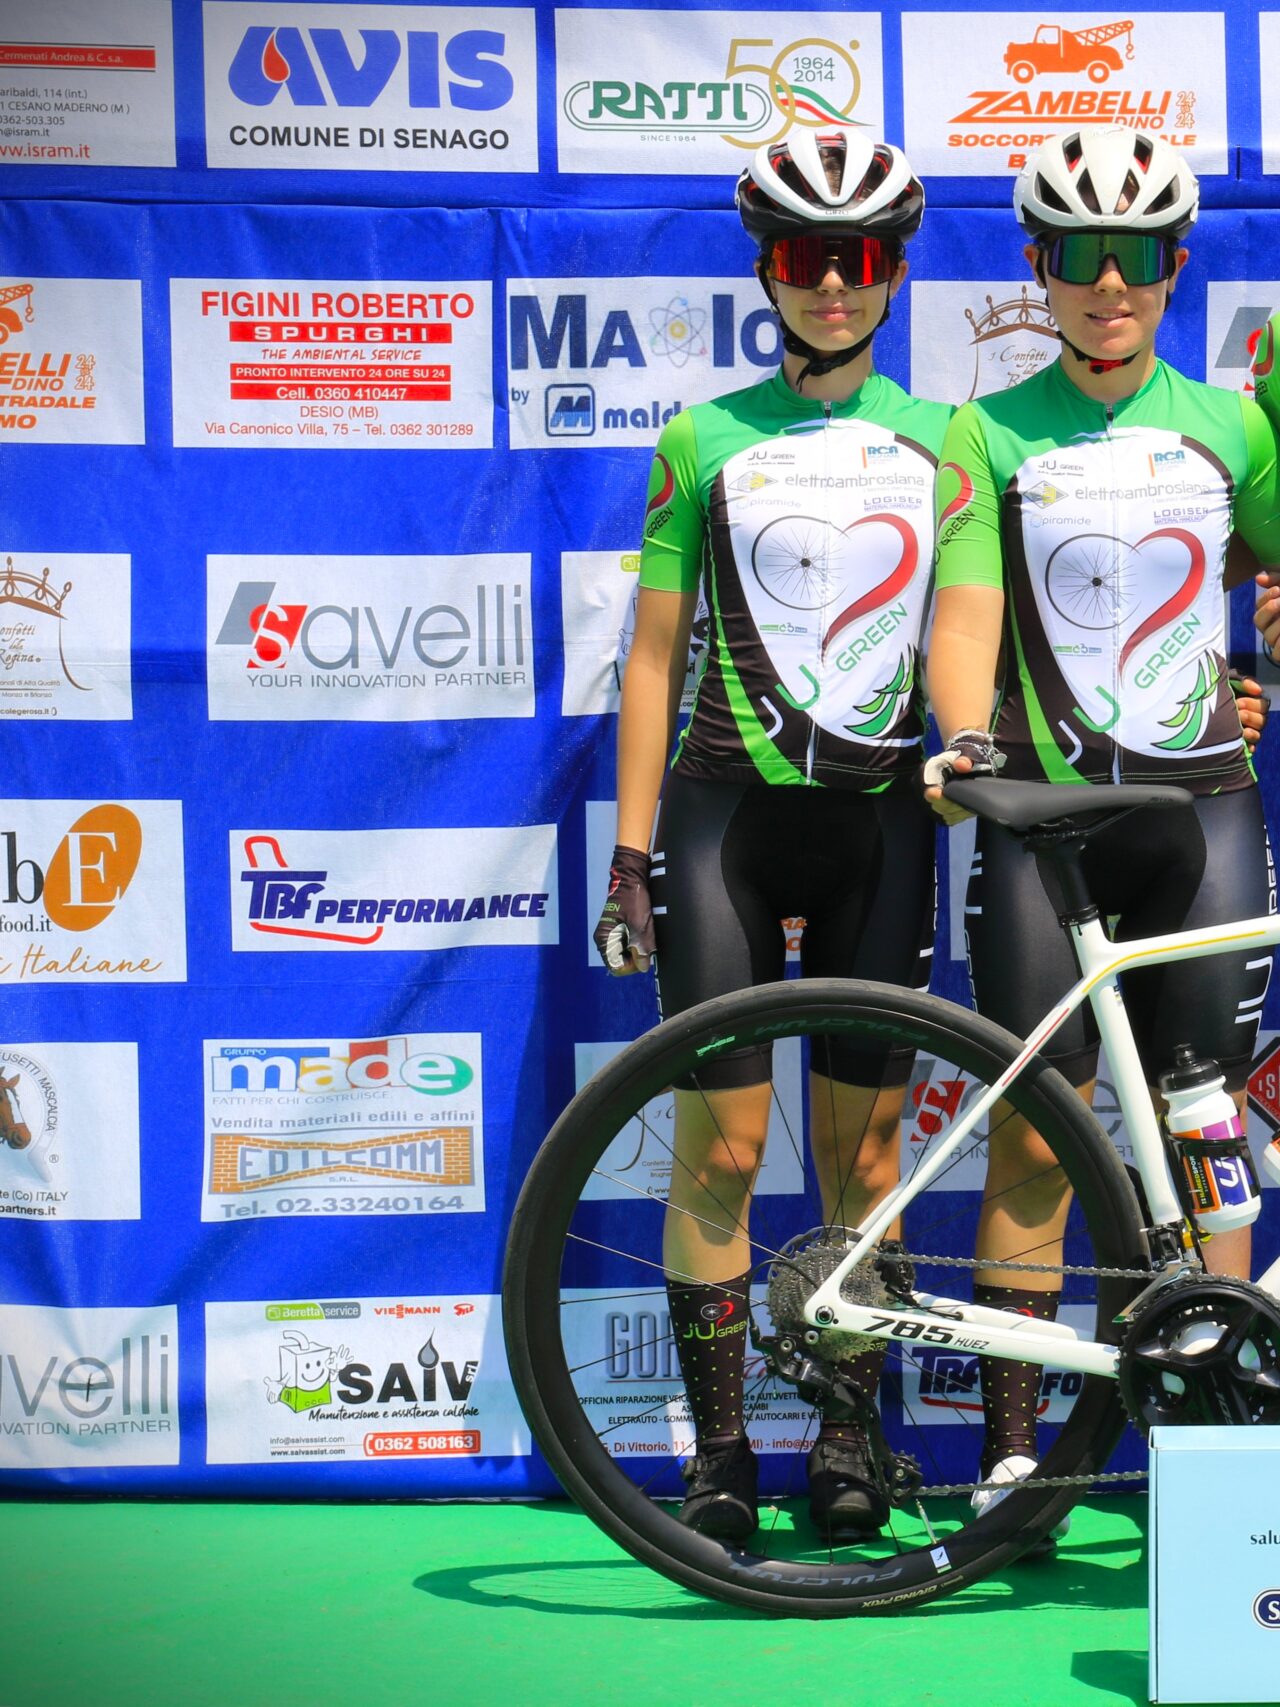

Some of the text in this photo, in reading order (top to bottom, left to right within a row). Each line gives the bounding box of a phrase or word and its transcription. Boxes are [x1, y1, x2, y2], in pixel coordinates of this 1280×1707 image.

[50, 53, 85, 62] Andrea
[793, 57, 835, 70] 1964
[228, 26, 514, 111] AVIS
[793, 70, 836, 83] 2014
[44, 89, 62, 97] 114
[8, 101, 108, 113] CESANO MADERNO
[589, 81, 748, 120] RATTI
[948, 90, 1171, 124] ZAMBELLI
[1114, 116, 1164, 129] DINO
[229, 125, 509, 150] COMUNE DI SENAGO
[640, 134, 671, 142] SINCE
[201, 291, 475, 319] FIGINI ROBERTO
[253, 326, 428, 341] SPURGHI
[261, 349, 422, 361] THE AMBIENTAL SERVICE
[235, 367, 445, 378] PRONTO INTERVENTO 24 ORE SU 24
[12, 378, 64, 391] DINO
[276, 386, 407, 400] Cell. 0360 410447
[511, 387, 529, 404] by
[0, 395, 96, 409] TRADALE
[299, 405, 379, 419] DESIO (MB)
[204, 423, 473, 437] Via Canonico Villa, 75 Tel. 0362 301289
[836, 602, 908, 673] GREEN
[1134, 613, 1201, 689] GREEN
[247, 670, 525, 688] YOUR INNOVATION PARTNER
[316, 893, 549, 924] PERFORMANCE
[21, 944, 162, 979] Italiane
[224, 1048, 266, 1056] GRUPPO
[212, 1038, 457, 1093] made
[213, 1097, 247, 1105] FATTI
[250, 1096, 273, 1105] PER
[278, 1096, 299, 1104] CHI
[211, 1117, 273, 1128] Vendita
[280, 1112, 362, 1128] materiali
[368, 1111, 408, 1122] edili
[430, 1110, 475, 1121] affini
[239, 1140, 442, 1181] EDILCOMM
[36, 1192, 69, 1201] ITALY
[221, 1196, 464, 1218] Tel. 02.33240164
[282, 1305, 321, 1318] Beretta
[325, 1305, 359, 1317] service
[865, 1316, 990, 1349] 785 HUEZ
[308, 1403, 479, 1421] Manutenzione assistenza caldaie
[78, 1420, 171, 1434] PARTNER
[375, 1437, 413, 1450] 0362
[418, 1436, 474, 1449] 508163
[614, 1441, 671, 1453] Di Vittorio,
